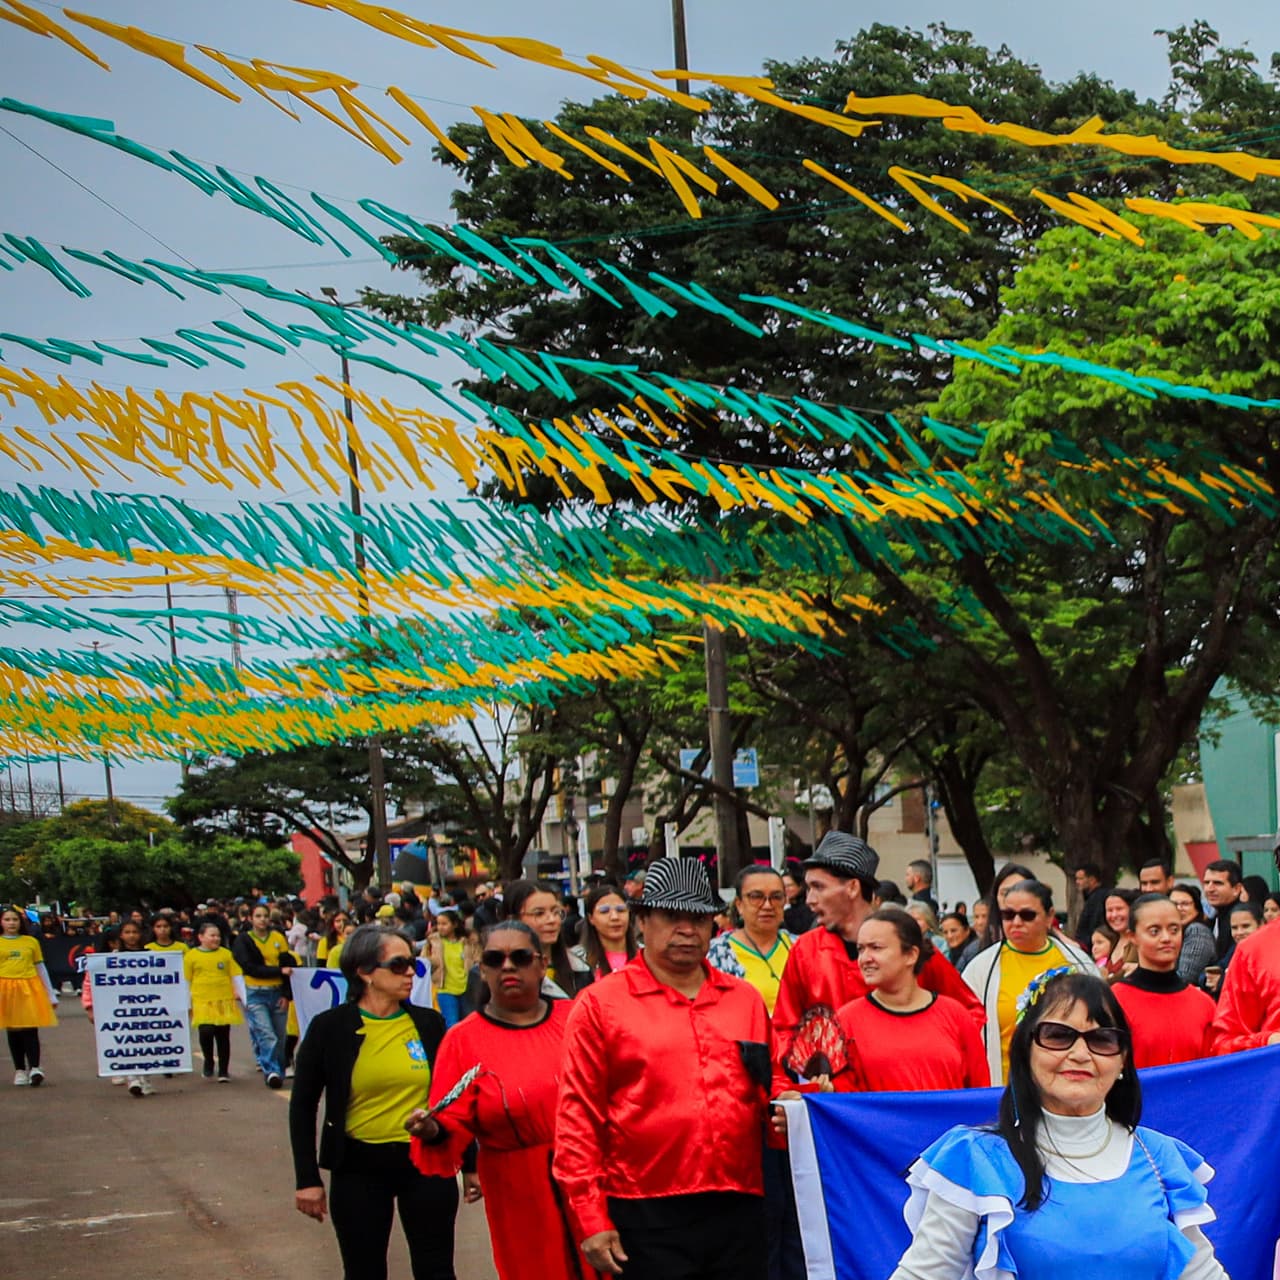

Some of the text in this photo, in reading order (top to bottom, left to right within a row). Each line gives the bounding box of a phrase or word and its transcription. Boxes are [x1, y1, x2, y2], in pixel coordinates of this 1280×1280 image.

[105, 955, 167, 969] Escola
[94, 971, 180, 986] Estadual
[113, 1007, 169, 1018] CLEUZA
[100, 1020, 184, 1032] APARECIDA
[113, 1033, 173, 1044] VARGAS
[103, 1046, 184, 1058] GALHARDO
